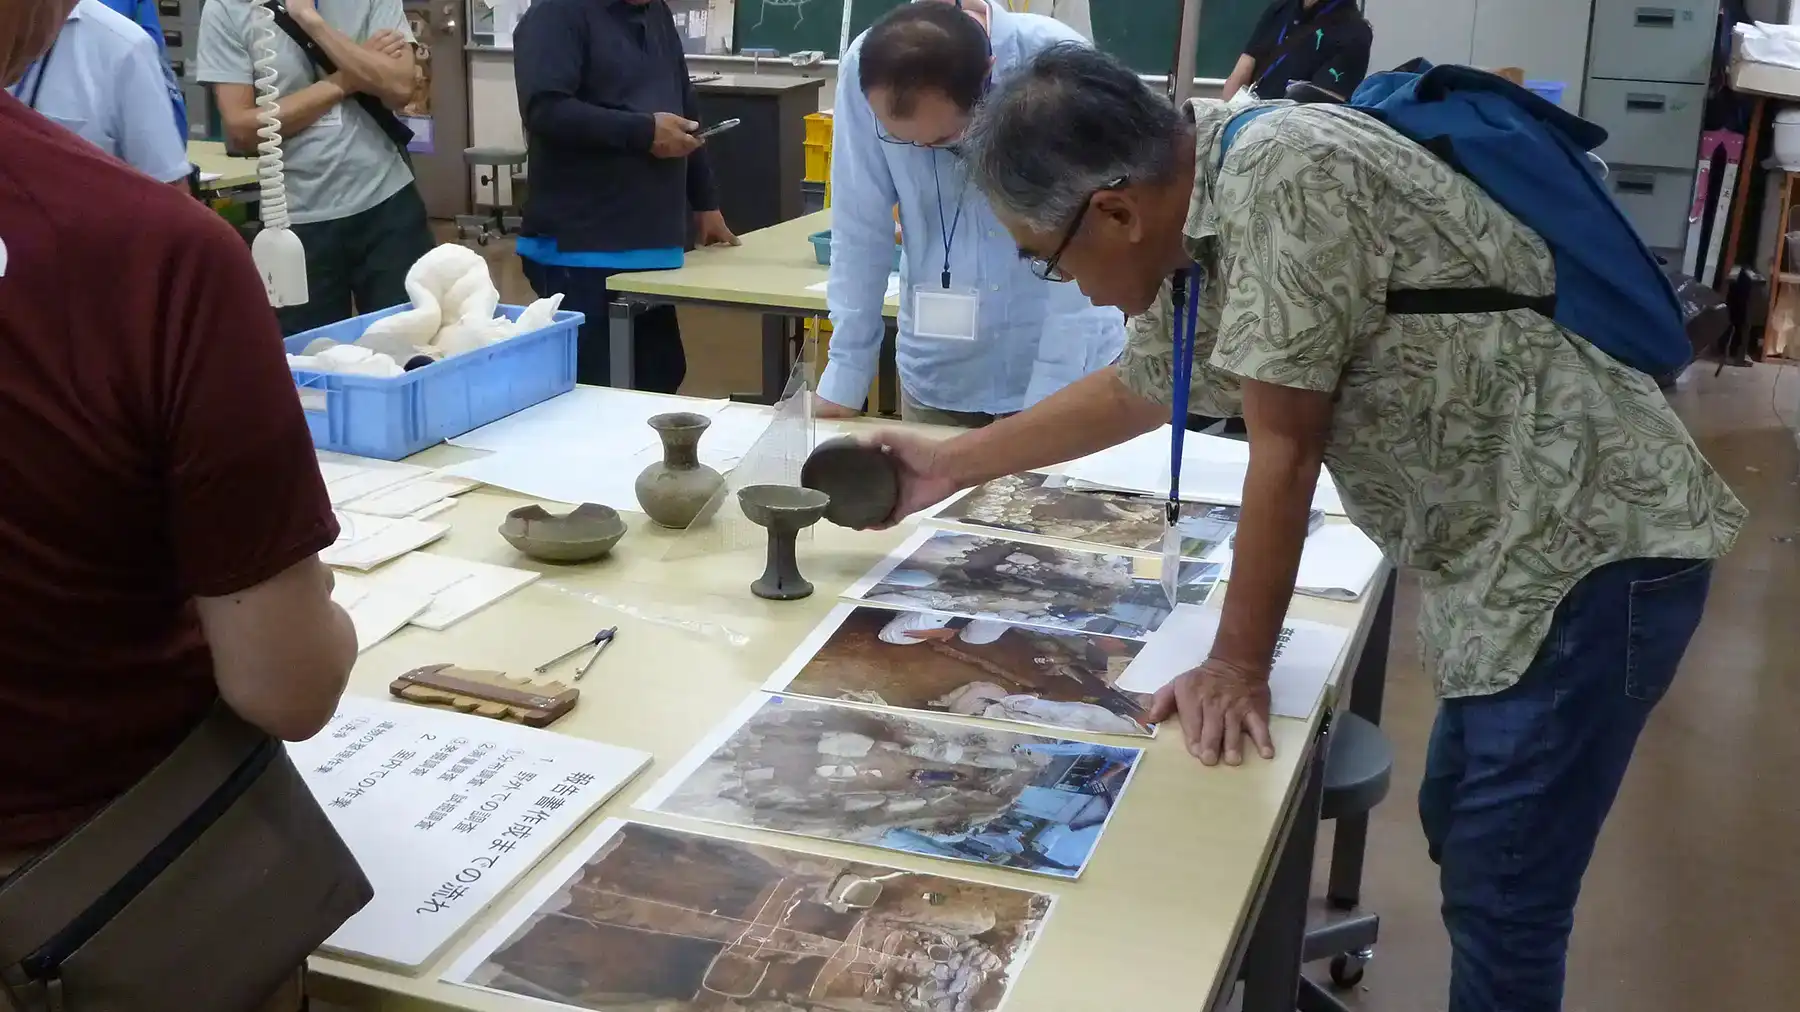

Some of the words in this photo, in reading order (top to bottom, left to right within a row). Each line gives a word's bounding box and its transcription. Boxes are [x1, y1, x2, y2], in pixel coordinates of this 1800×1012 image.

[328, 749, 416, 808] 室内での作業
[451, 770, 537, 834] 野外での調査
[415, 771, 596, 915] 報告書作成までの流れ
